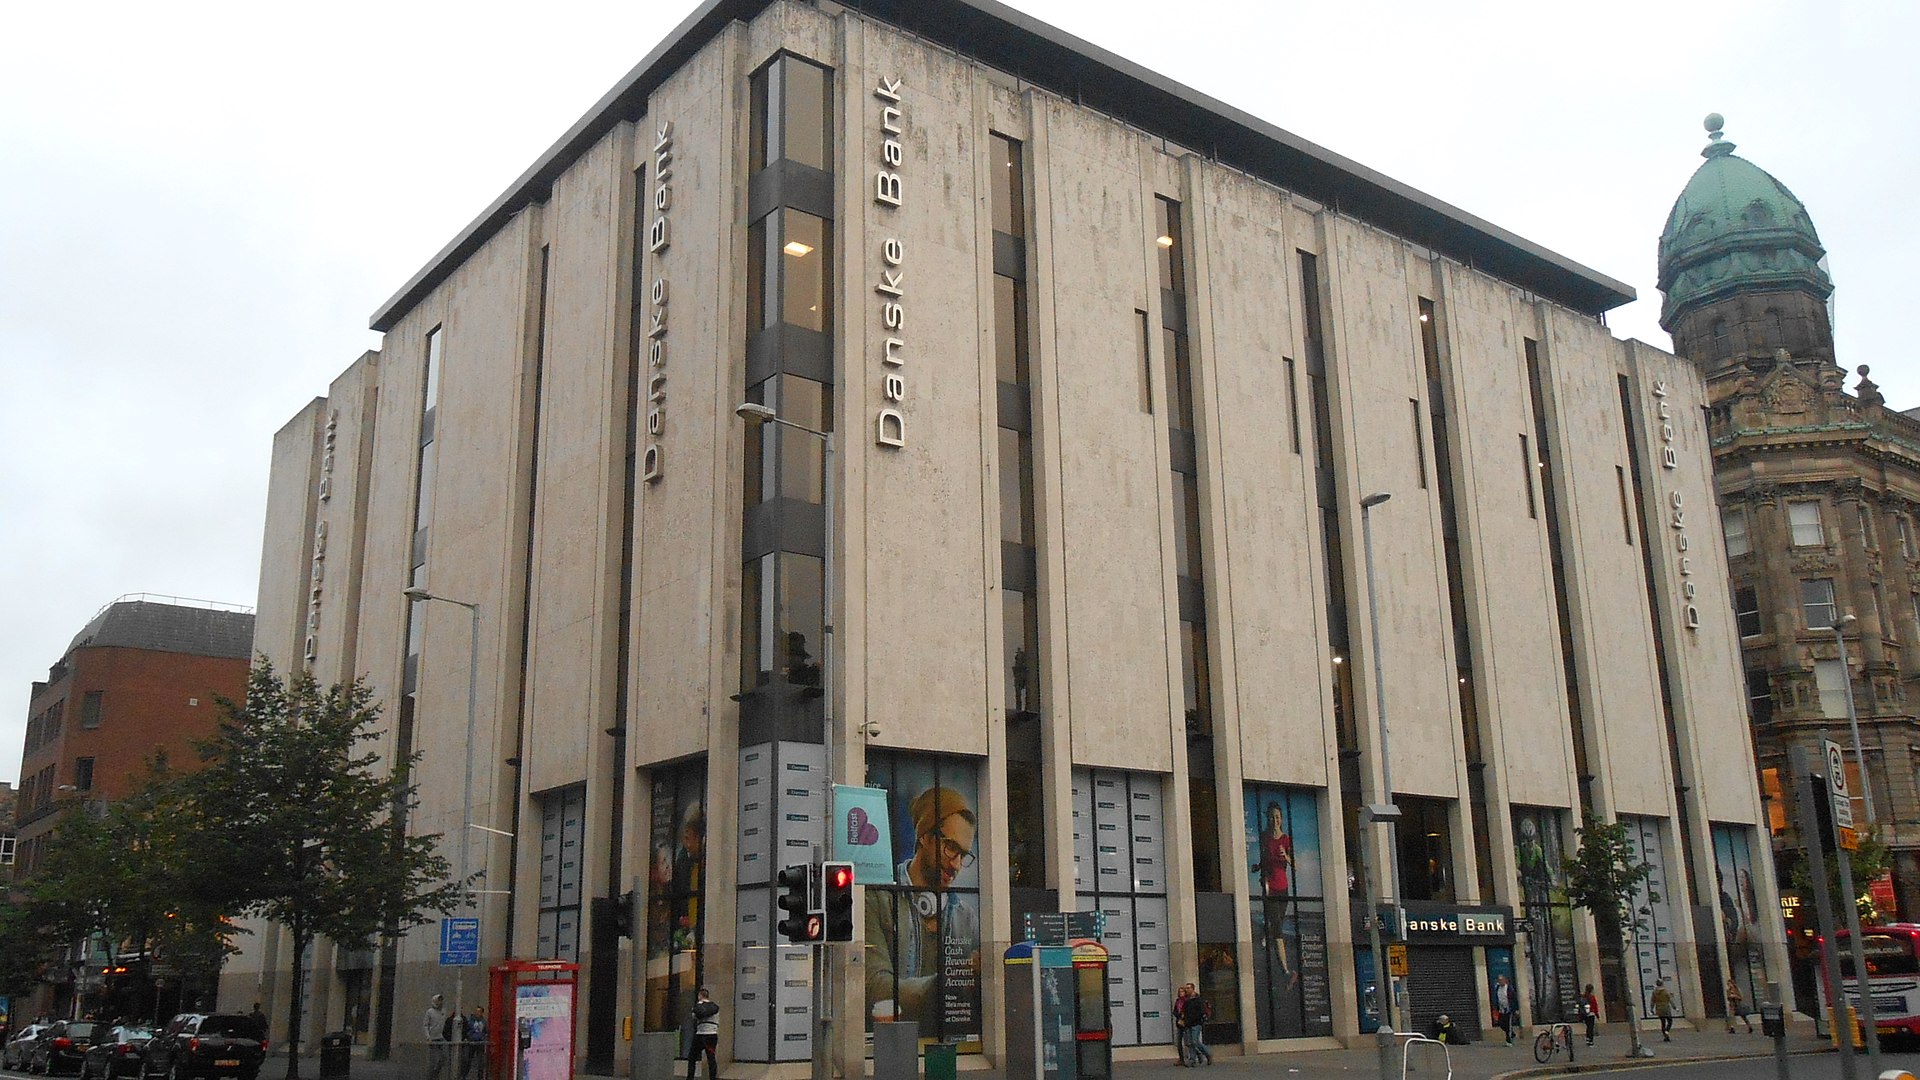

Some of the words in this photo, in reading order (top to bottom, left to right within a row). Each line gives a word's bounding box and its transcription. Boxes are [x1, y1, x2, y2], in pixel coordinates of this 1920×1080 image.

[874, 76, 902, 207] Bank
[651, 120, 674, 253] Bank
[875, 238, 905, 449] Danske
[643, 278, 670, 483] Danske
[1653, 380, 1678, 470] Bank
[305, 520, 328, 662] Danske
[319, 409, 339, 502] Bank
[1669, 490, 1700, 630] Danske
[851, 813, 859, 843] Belfast
[944, 935, 972, 945] Danske
[944, 946, 963, 955] Cash
[1409, 918, 1457, 931] anske
[1465, 918, 1505, 931] Bank
[944, 956, 973, 966] Reward
[945, 967, 974, 976] Current
[945, 978, 975, 987] Account
